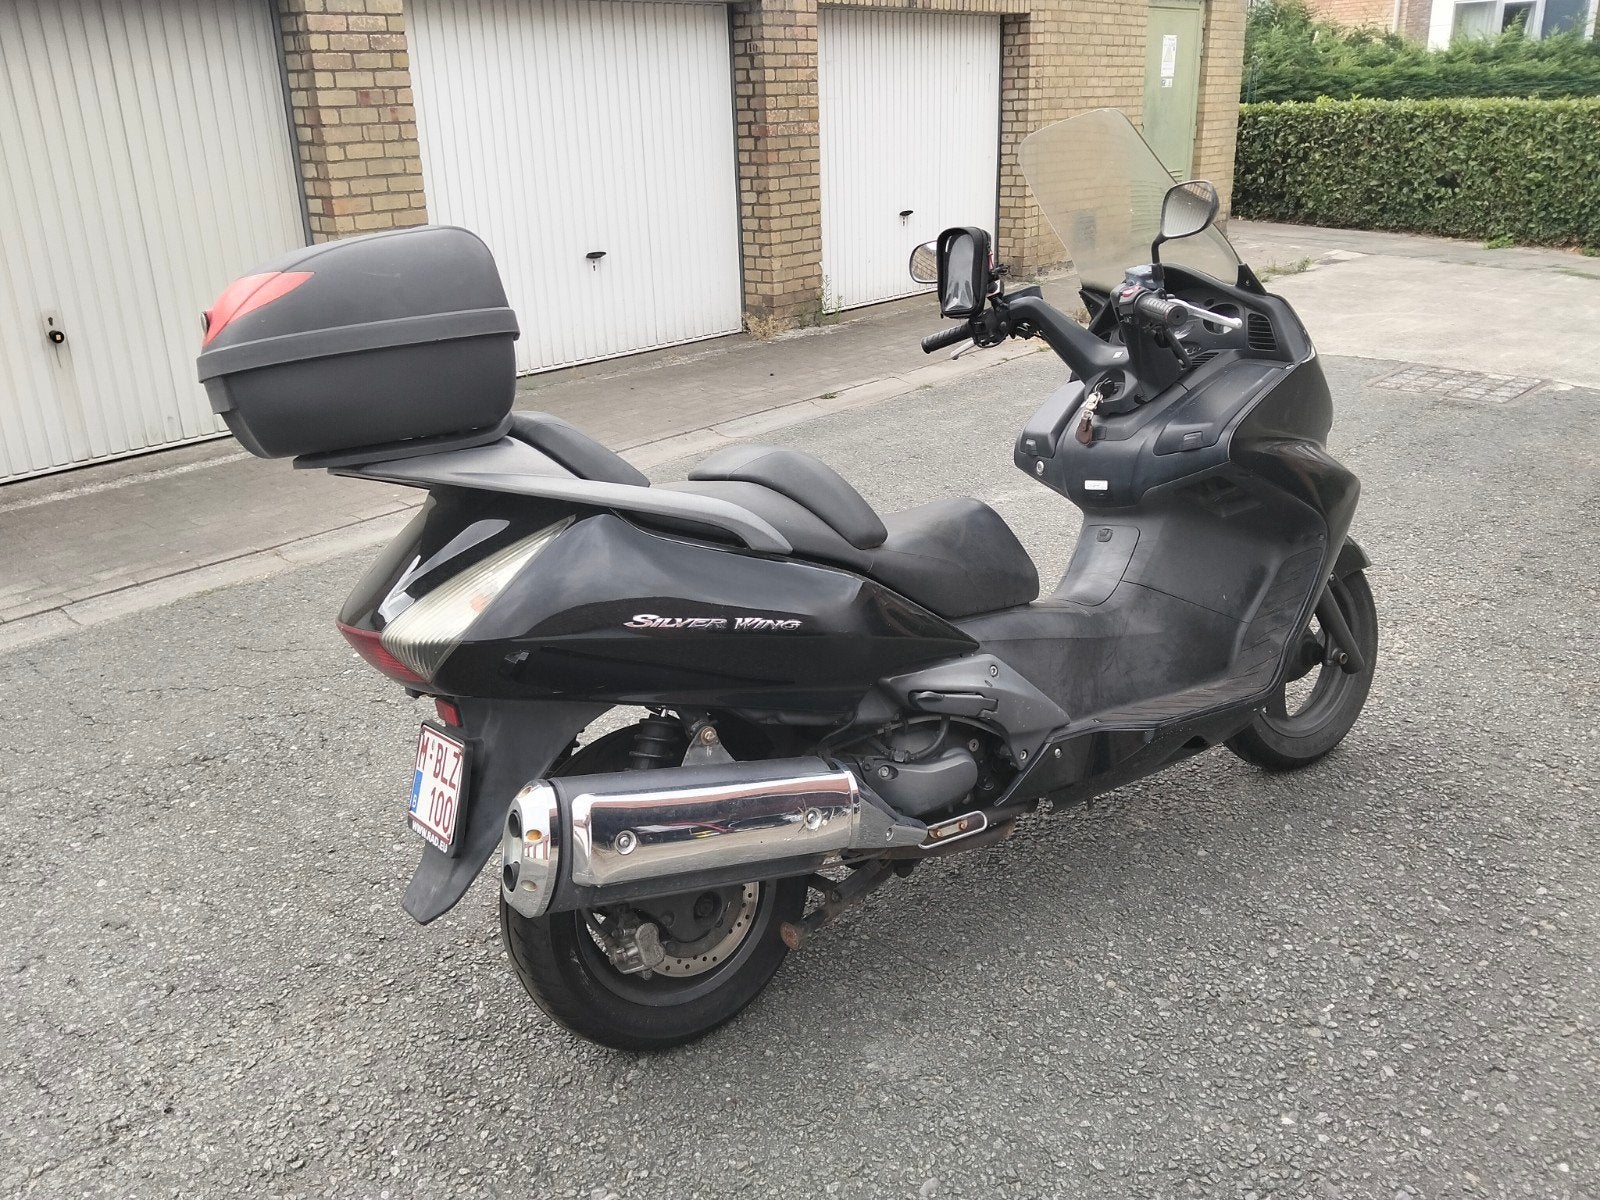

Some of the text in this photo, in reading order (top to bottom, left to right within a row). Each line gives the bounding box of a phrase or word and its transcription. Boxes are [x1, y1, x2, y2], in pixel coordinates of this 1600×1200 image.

[623, 613, 803, 631] SILVER WING
[428, 786, 453, 834] 100
